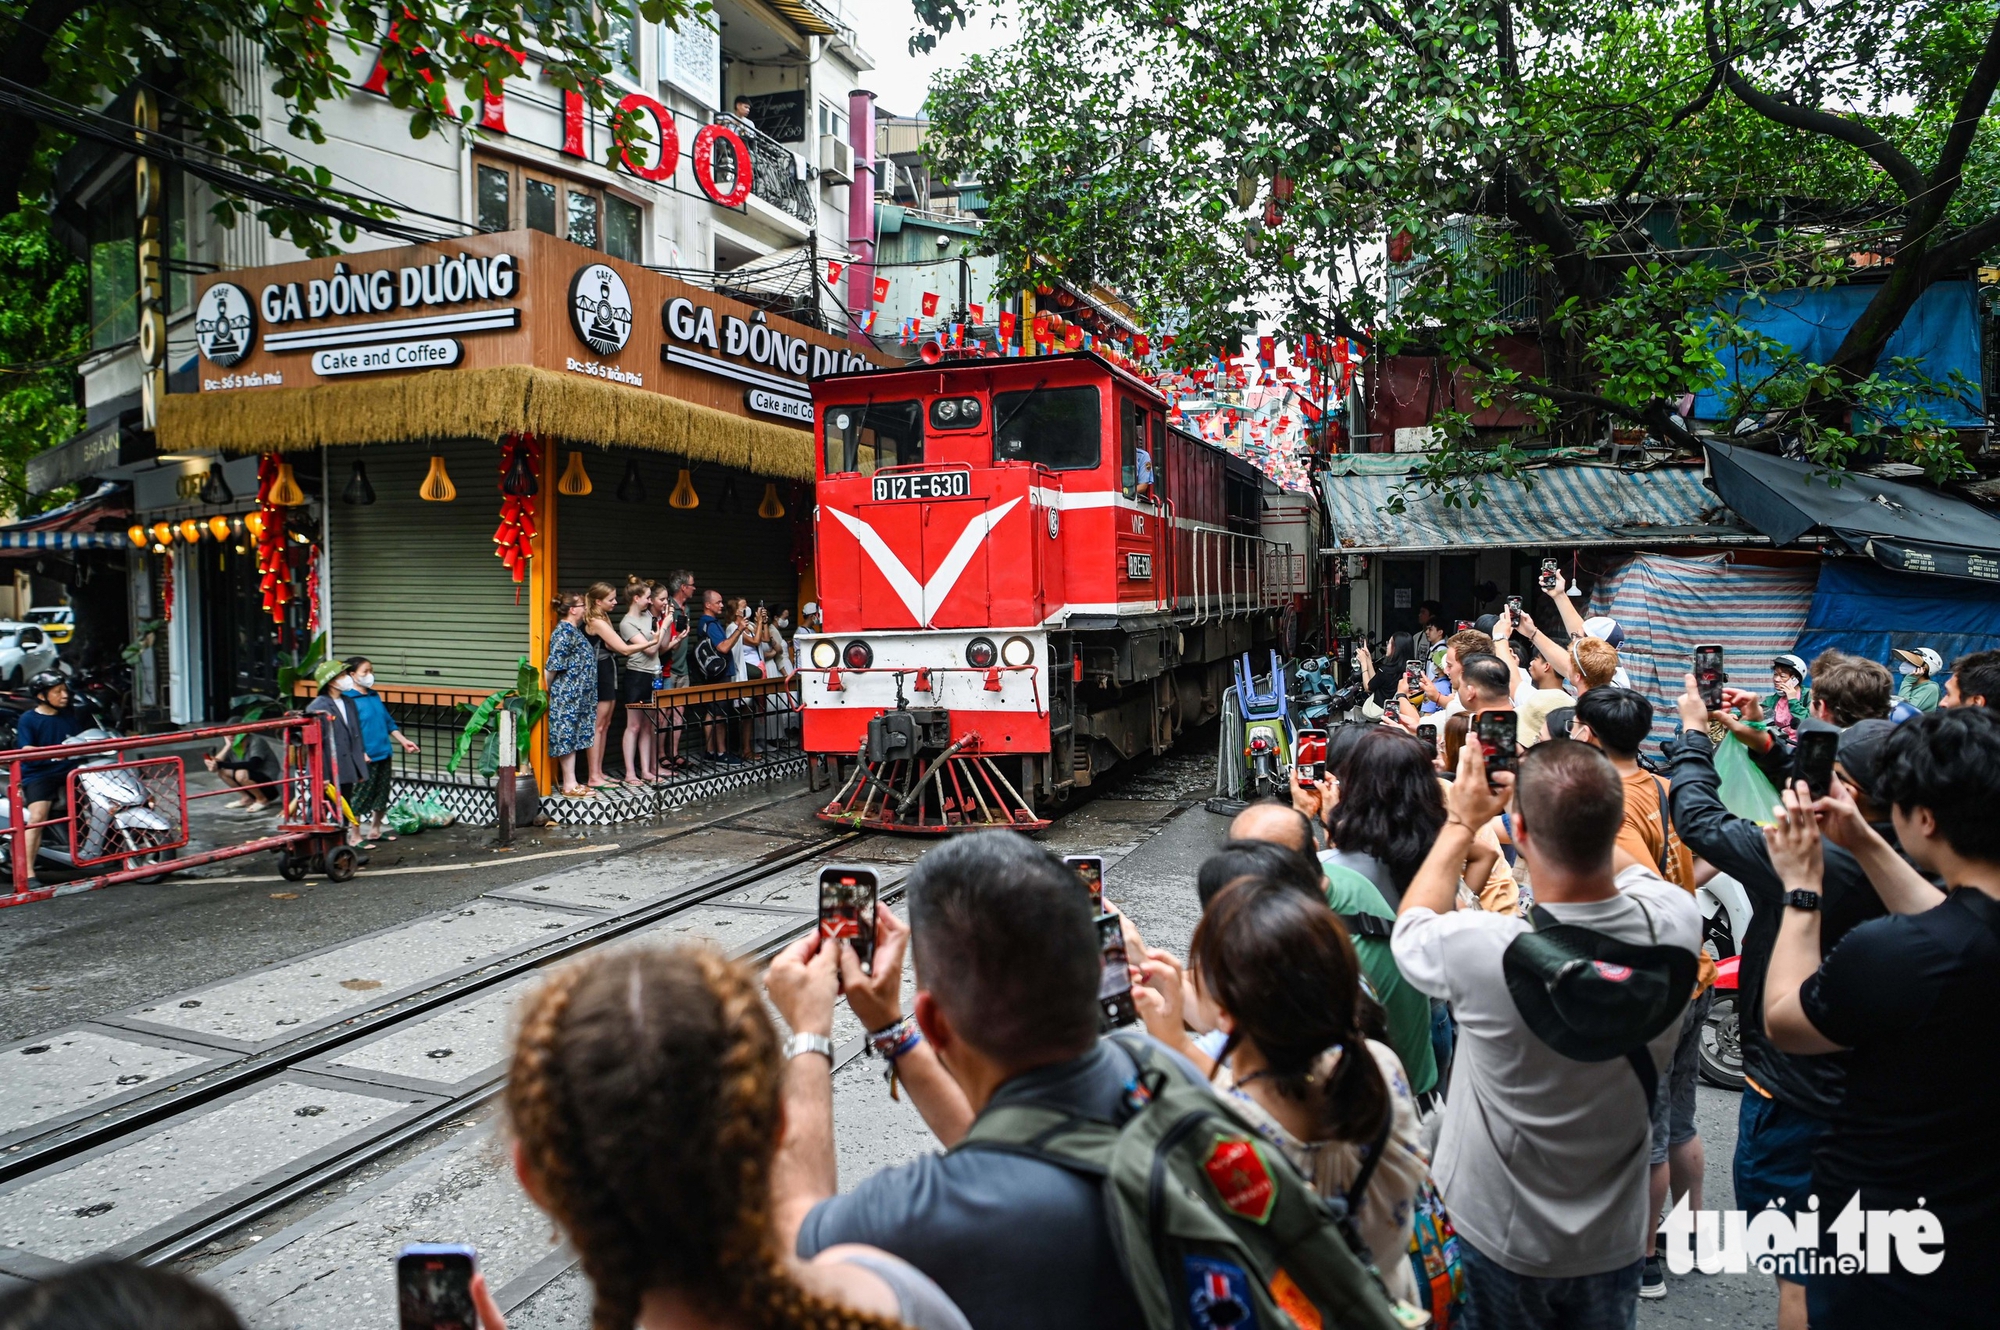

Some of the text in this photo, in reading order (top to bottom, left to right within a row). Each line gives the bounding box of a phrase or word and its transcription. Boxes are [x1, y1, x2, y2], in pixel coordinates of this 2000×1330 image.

[261, 252, 514, 323] GA ĐÔNG DƯƠNG
[668, 297, 719, 349] GA
[726, 311, 808, 376] ĐÔNG
[321, 344, 447, 370] Cake and Coffee
[235, 375, 243, 388] 5
[585, 361, 598, 377] Số
[600, 367, 606, 378] 5
[606, 365, 626, 383] Trần
[626, 372, 643, 387] Phú
[756, 393, 780, 411] Cake
[782, 402, 799, 415] and
